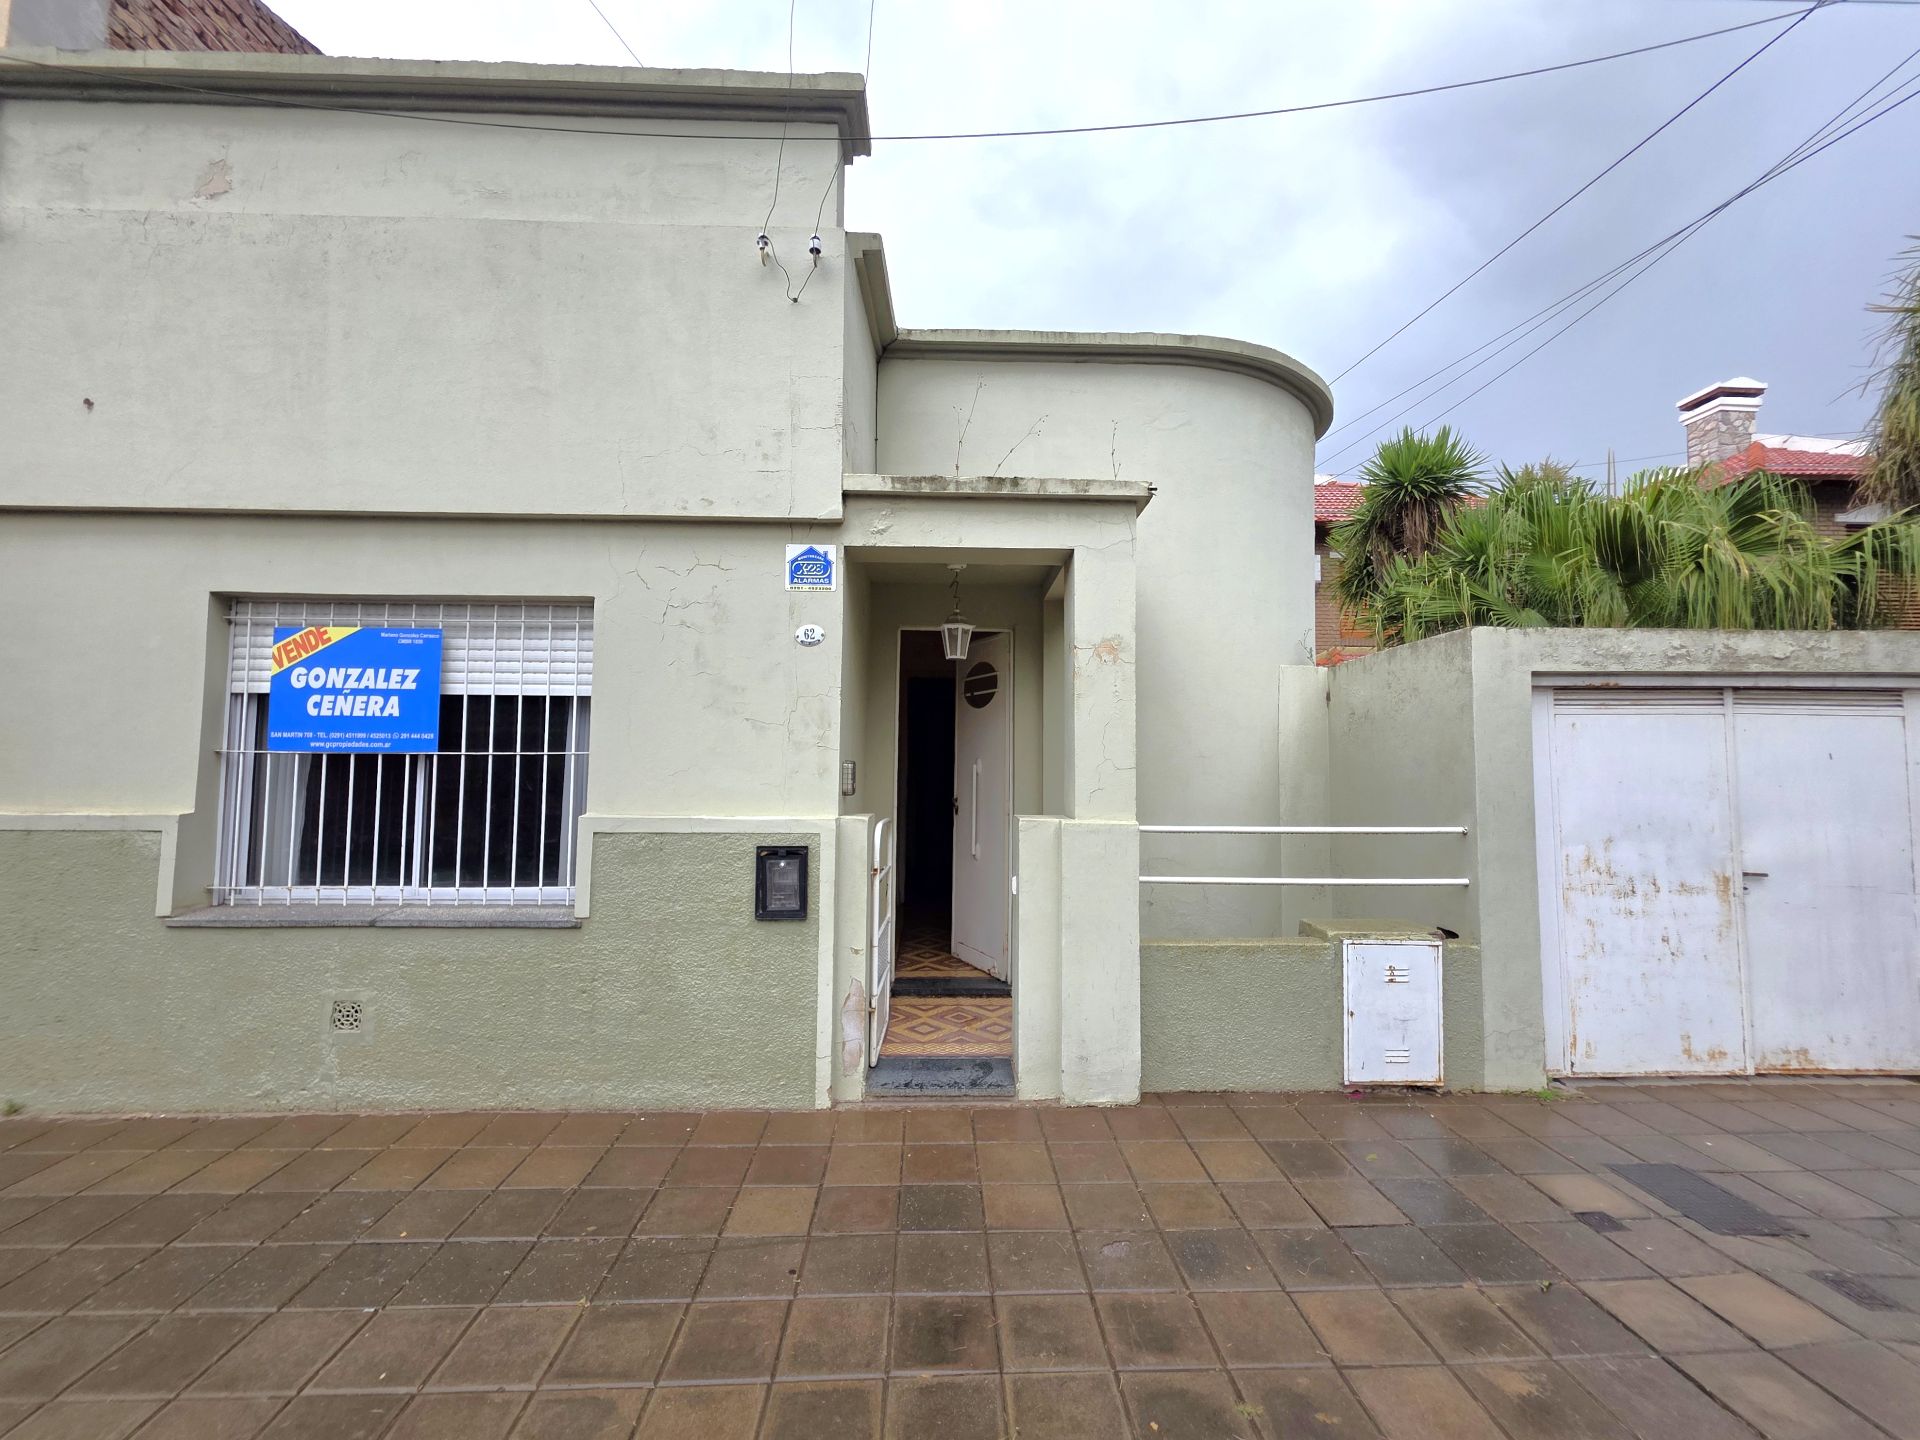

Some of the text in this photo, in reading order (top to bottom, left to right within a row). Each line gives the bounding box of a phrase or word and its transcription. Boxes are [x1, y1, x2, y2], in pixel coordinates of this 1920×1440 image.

[804, 628, 815, 640] 62
[272, 626, 332, 669] VENDE
[290, 667, 420, 690] GONZALEZ
[306, 689, 400, 717] CEÑERA
